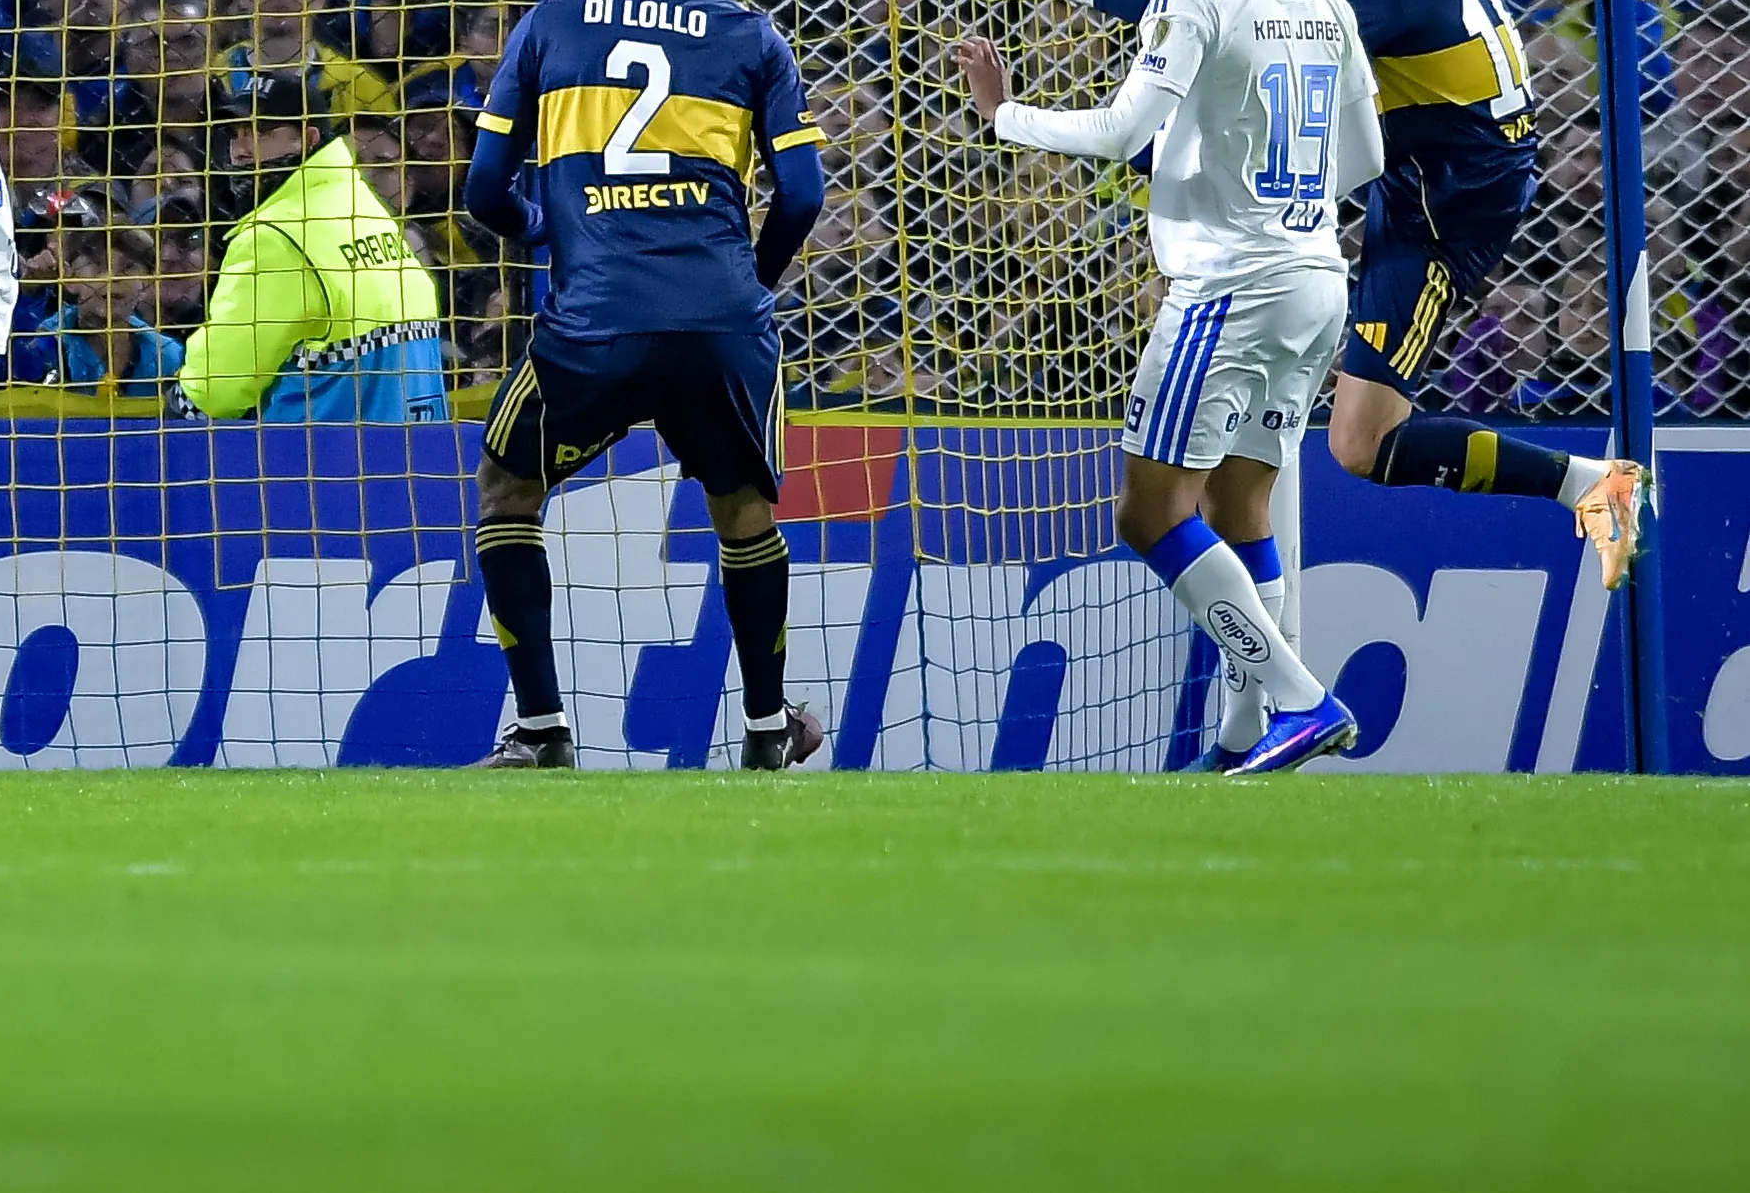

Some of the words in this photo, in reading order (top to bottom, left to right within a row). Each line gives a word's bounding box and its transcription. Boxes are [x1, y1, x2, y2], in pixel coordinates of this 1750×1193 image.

[622, 0, 708, 38] LOLLO
[1253, 20, 1291, 41] KAIO
[1295, 20, 1342, 42] JORGE
[603, 39, 671, 175] 2
[1255, 63, 1339, 199] 19
[583, 181, 710, 215] DIRECTV
[1214, 607, 1264, 658] Kodilar
